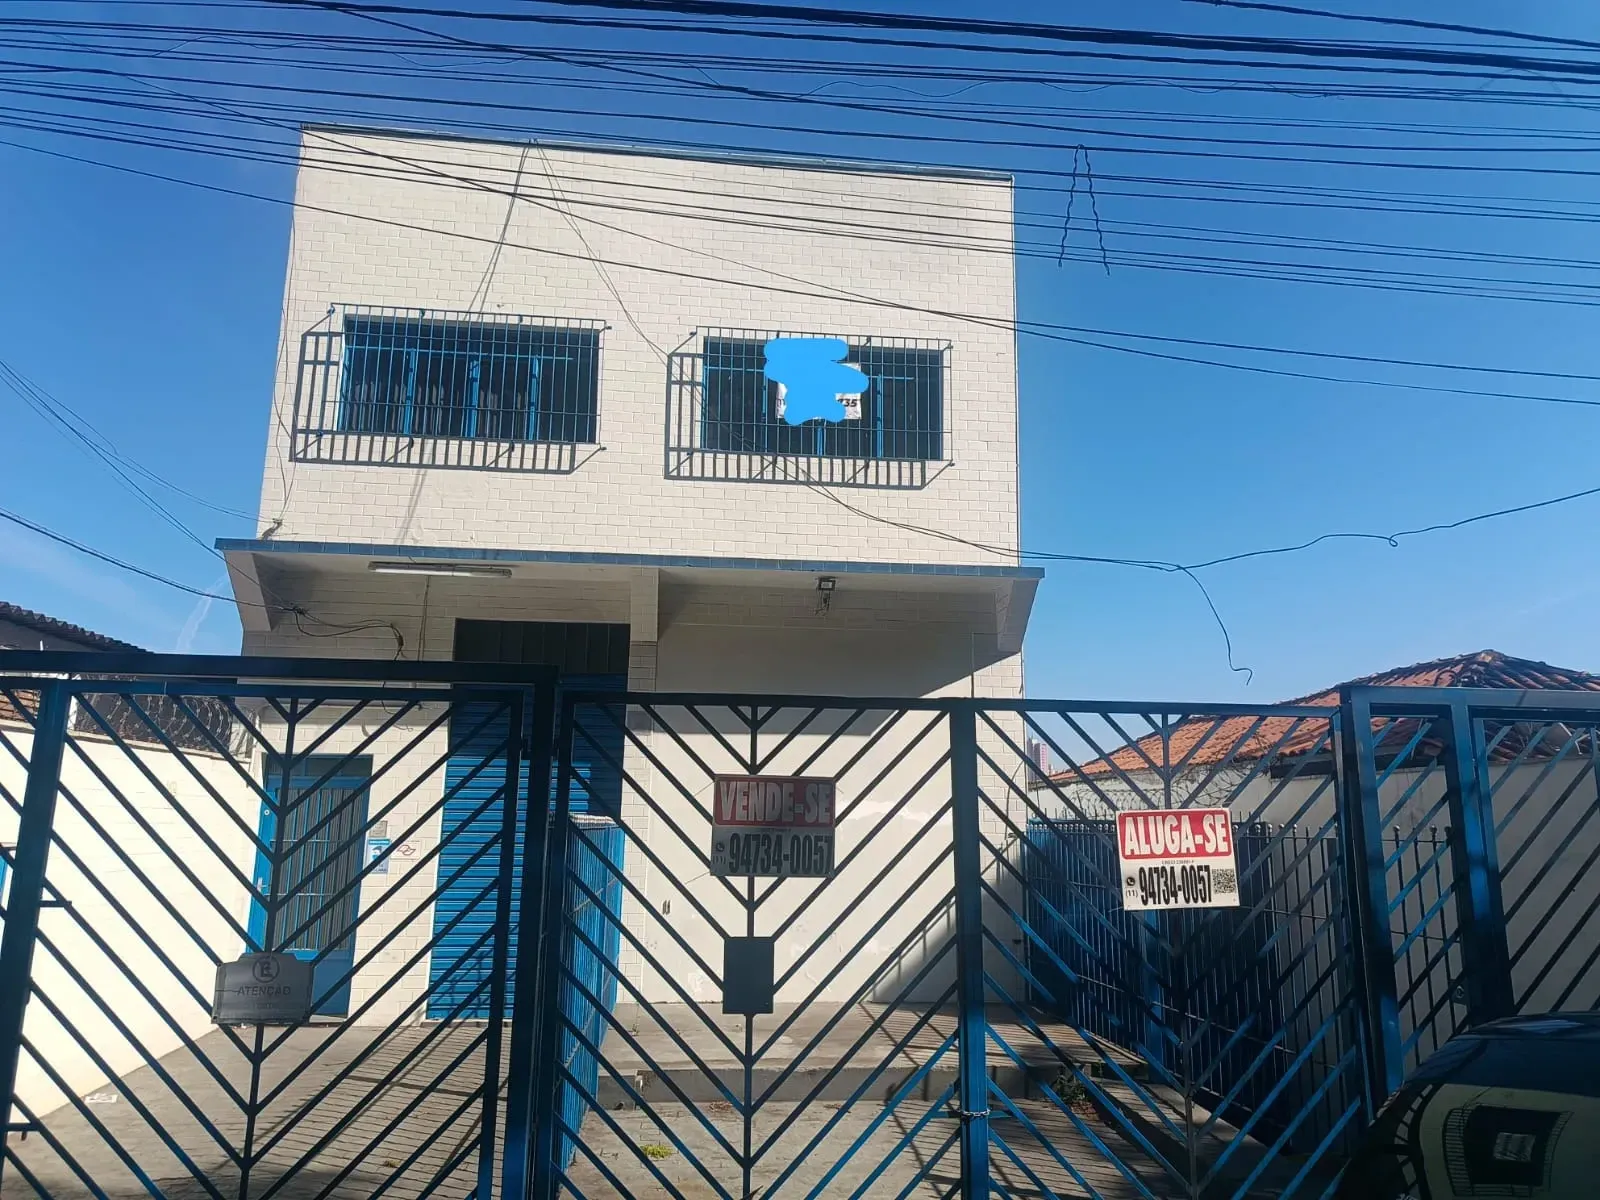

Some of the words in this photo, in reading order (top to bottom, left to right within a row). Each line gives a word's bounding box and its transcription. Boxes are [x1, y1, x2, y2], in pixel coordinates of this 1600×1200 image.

[720, 781, 831, 823] VENDE-SE
[728, 832, 833, 875] 94734-0057
[1124, 813, 1229, 856] ALUGA-SE
[1125, 889, 1138, 898] (11)
[1138, 865, 1212, 906] 94734-0057
